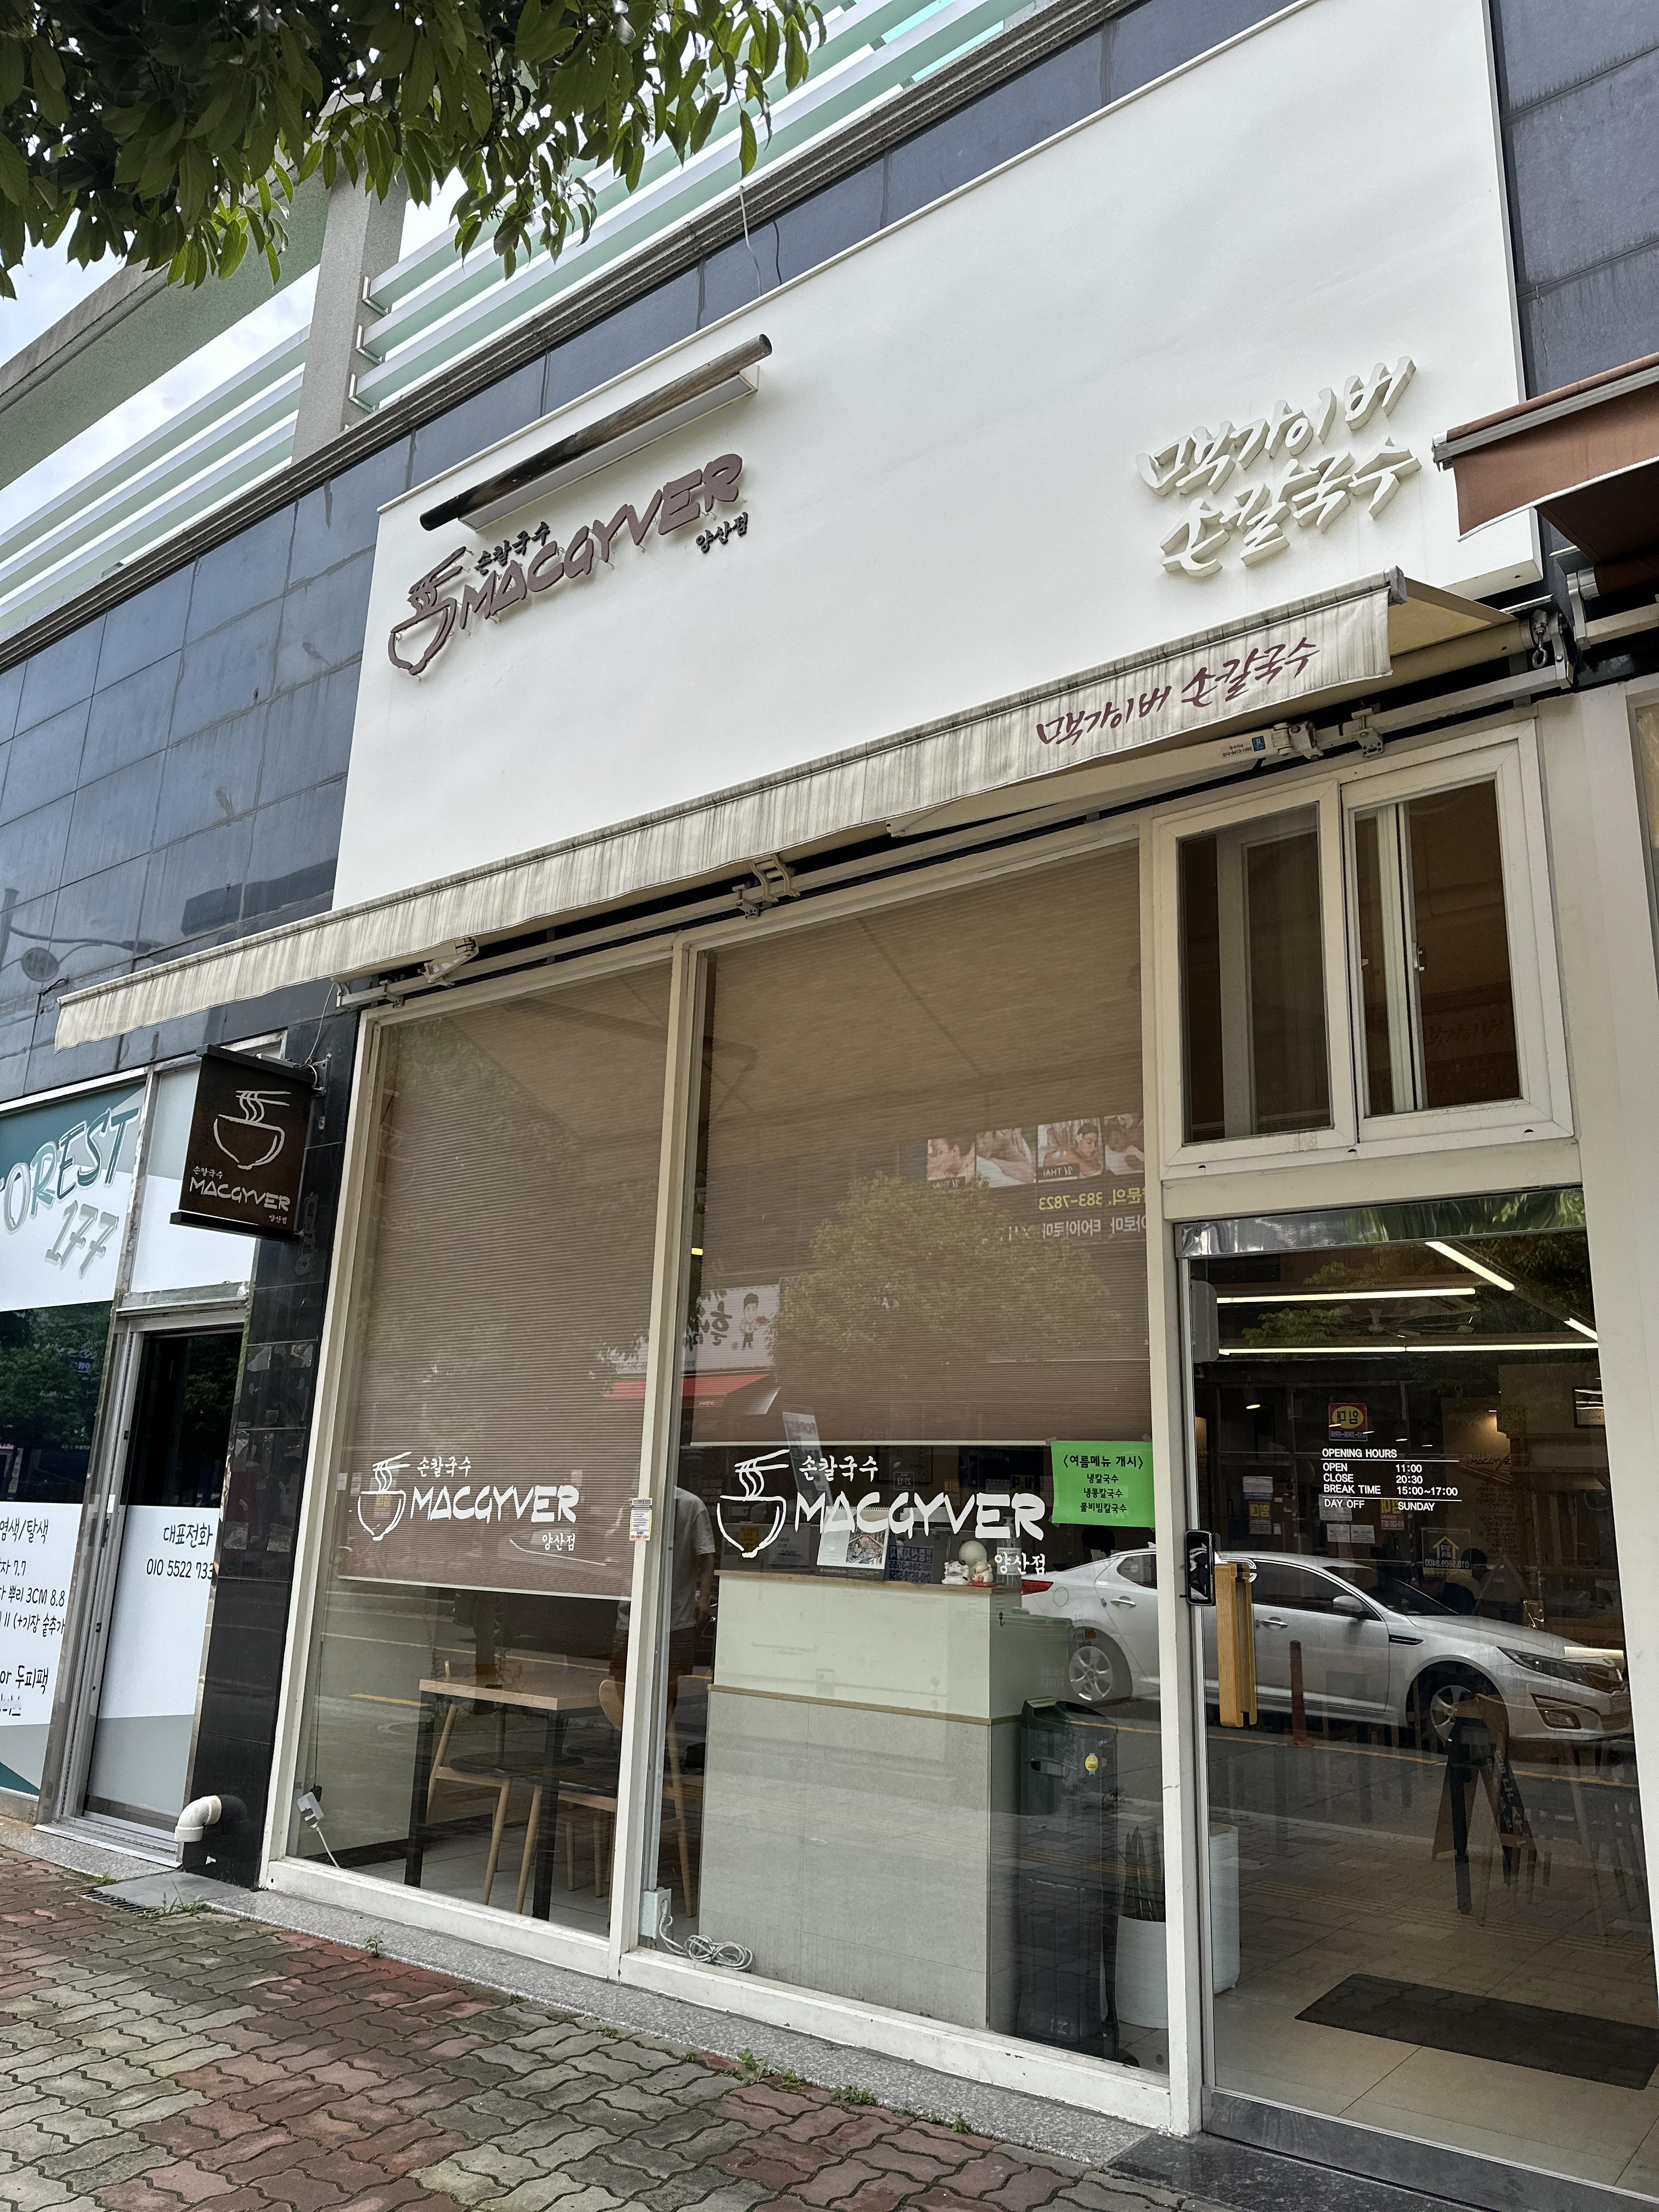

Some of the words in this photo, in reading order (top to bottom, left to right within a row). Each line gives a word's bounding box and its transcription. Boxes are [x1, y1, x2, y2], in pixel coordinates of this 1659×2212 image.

[1135, 356, 1417, 496] 맥가이버
[1160, 436, 1422, 578] 손칼국수
[459, 453, 743, 631] MACGYVER
[695, 511, 749, 554] 양산점
[473, 521, 551, 575] 손칼국수
[1036, 685, 1172, 746] 맥가이버
[1181, 636, 1321, 708] 손칼국수
[0, 1107, 140, 1235] OREST
[193, 1166, 223, 1180] 손칼국수
[190, 1177, 291, 1211] MACGYVER
[269, 1214, 287, 1224] 양산점
[44, 1200, 119, 1279] 177
[1322, 1448, 1363, 1458] OPENING
[1365, 1448, 1397, 1459] HOURS
[416, 1455, 472, 1478] 손칼국수
[798, 1454, 879, 1482] 손칼국수
[1323, 1463, 1348, 1472] OPEN
[1396, 1464, 1423, 1473] 11:00
[1087, 1473, 1119, 1484] 냉칼국수
[1323, 1474, 1354, 1483] CLOSE
[1396, 1475, 1423, 1484] 20:30
[1323, 1484, 1355, 1494] BREAK
[1358, 1485, 1381, 1494] TIME
[1397, 1486, 1458, 1496] 15:00~17:00
[410, 1485, 580, 1524] MACGYVER
[1084, 1488, 1123, 1499] 냉콩칼국수
[1324, 1499, 1342, 1508] DAY
[1346, 1500, 1365, 1509] OFF
[1397, 1502, 1435, 1511] SUNDAY
[794, 1491, 1046, 1541] MACGYVER
[1080, 1502, 1127, 1514] 물비빔칼국수
[0, 1516, 49, 1544] 염색/탈색
[163, 1523, 213, 1549] 대표전화
[541, 1532, 576, 1552] 양산점
[0, 1558, 11, 1575] 자
[13, 1560, 26, 1576] 7.7
[146, 1558, 164, 1577] 010
[167, 1560, 191, 1579] 5522
[994, 1553, 1046, 1576] 양산점
[8, 1585, 23, 1602] 뿌리
[26, 1587, 47, 1605] 3CM
[50, 1589, 65, 1607] 8.8
[13, 1612, 41, 1633] (+기장
[15, 1664, 49, 1695] 두피팩
